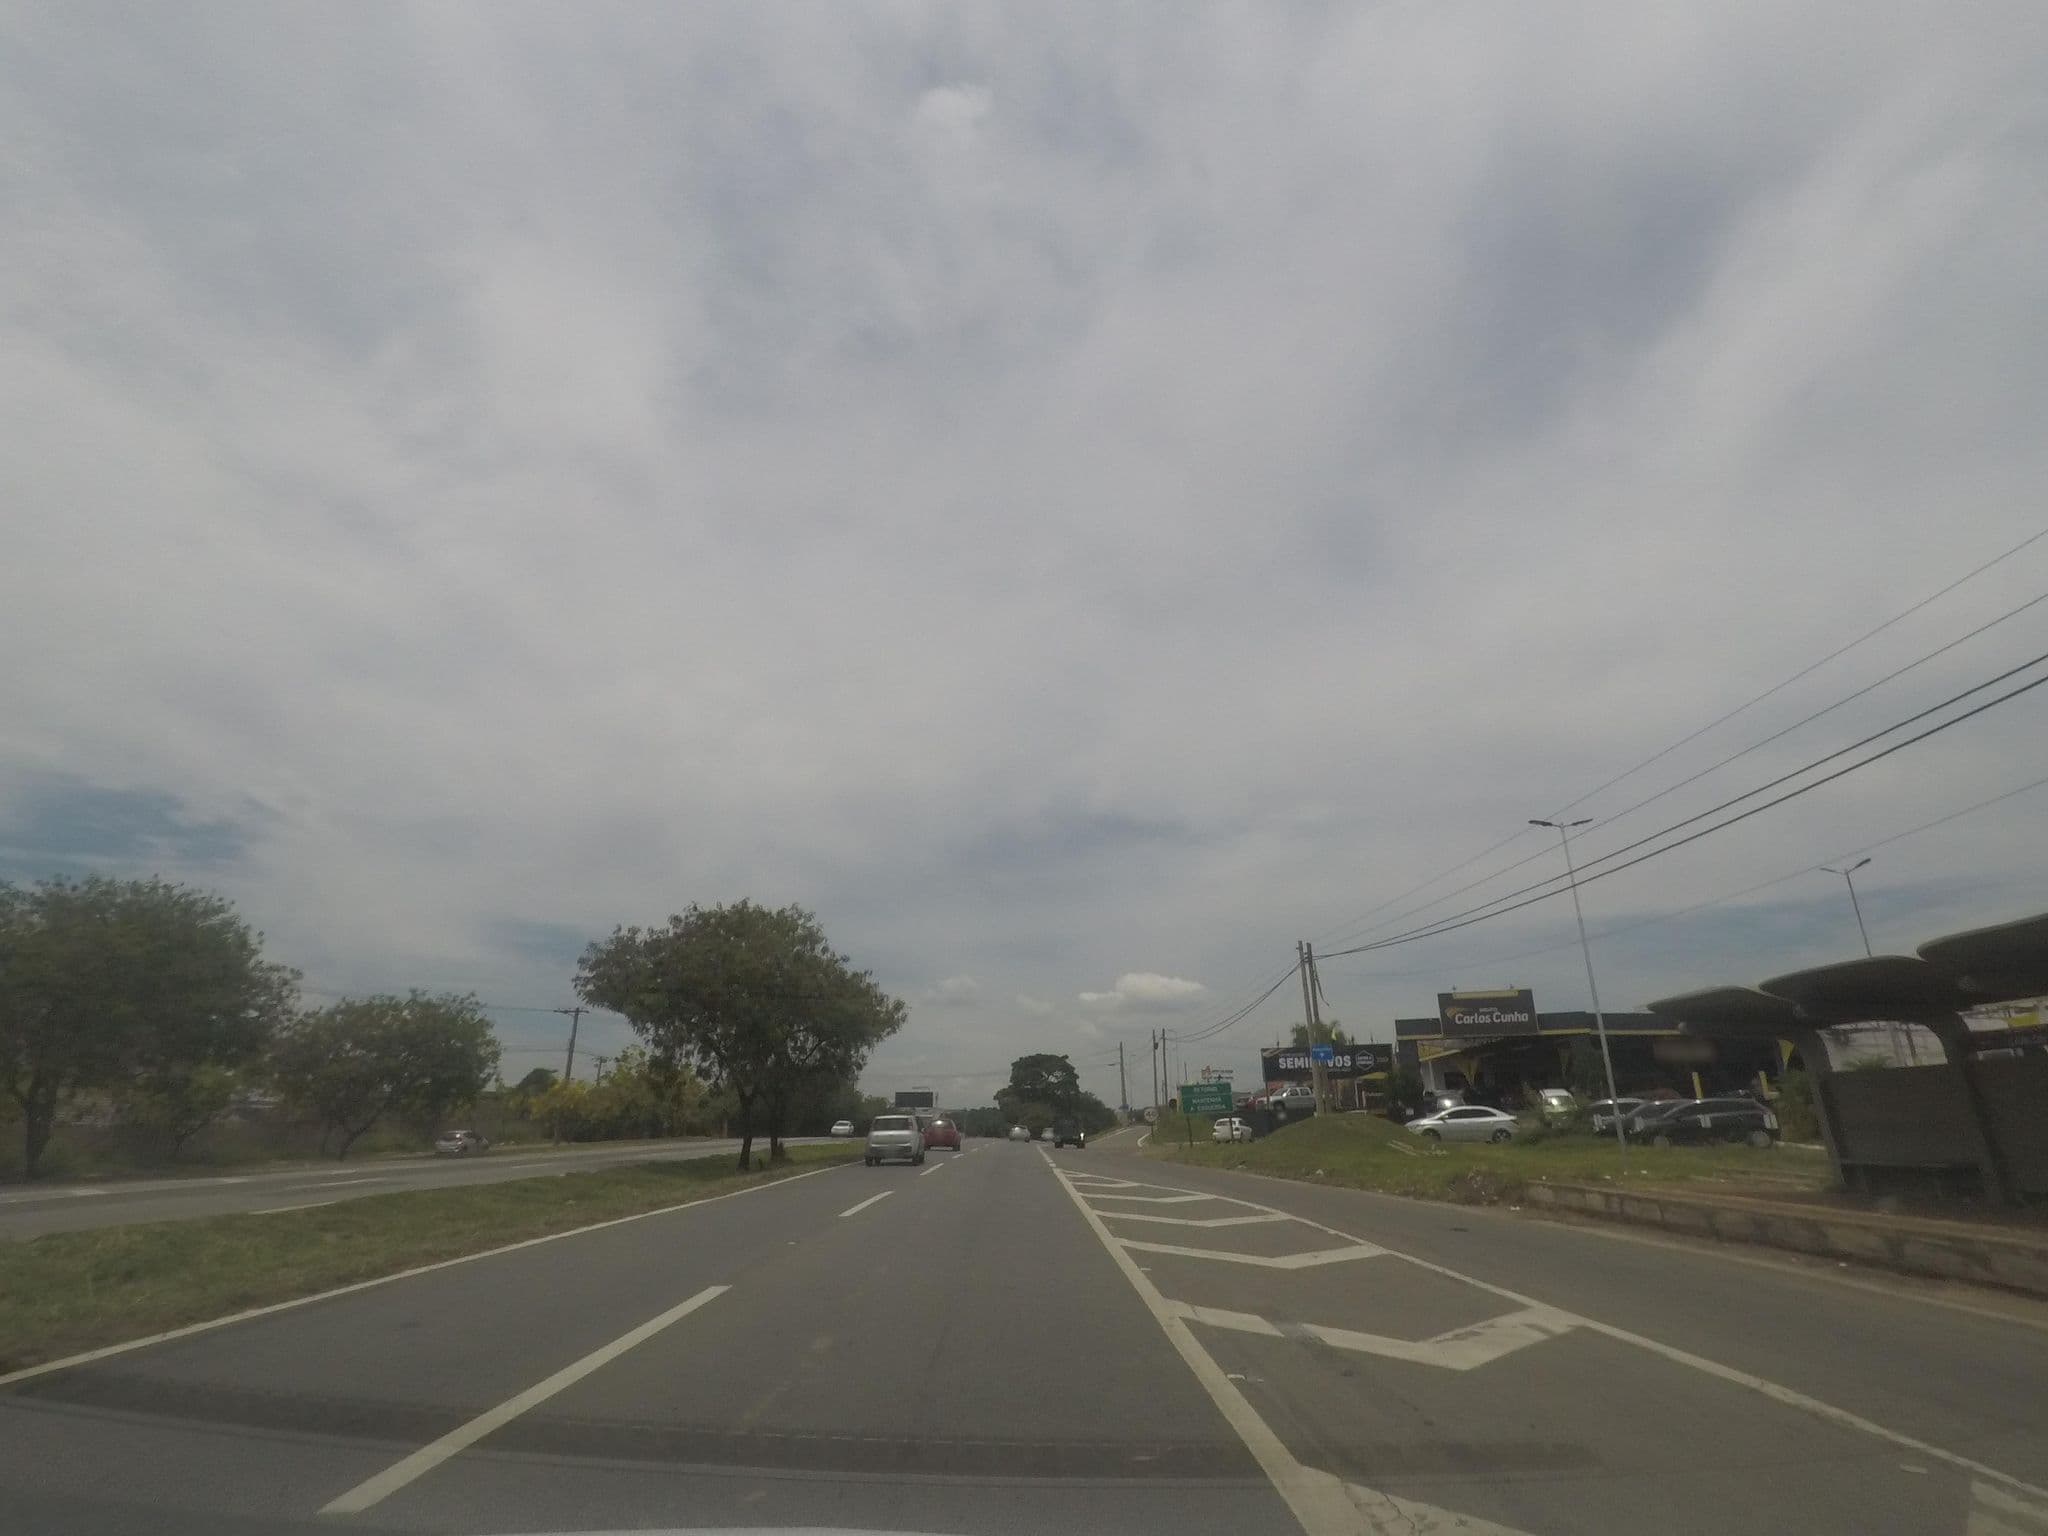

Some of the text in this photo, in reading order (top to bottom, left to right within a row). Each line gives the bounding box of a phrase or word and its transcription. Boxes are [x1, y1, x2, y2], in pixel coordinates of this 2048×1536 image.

[1455, 1011, 1529, 1024] Carlos Cunha
[1278, 1055, 1352, 1069] SEMIVOS
